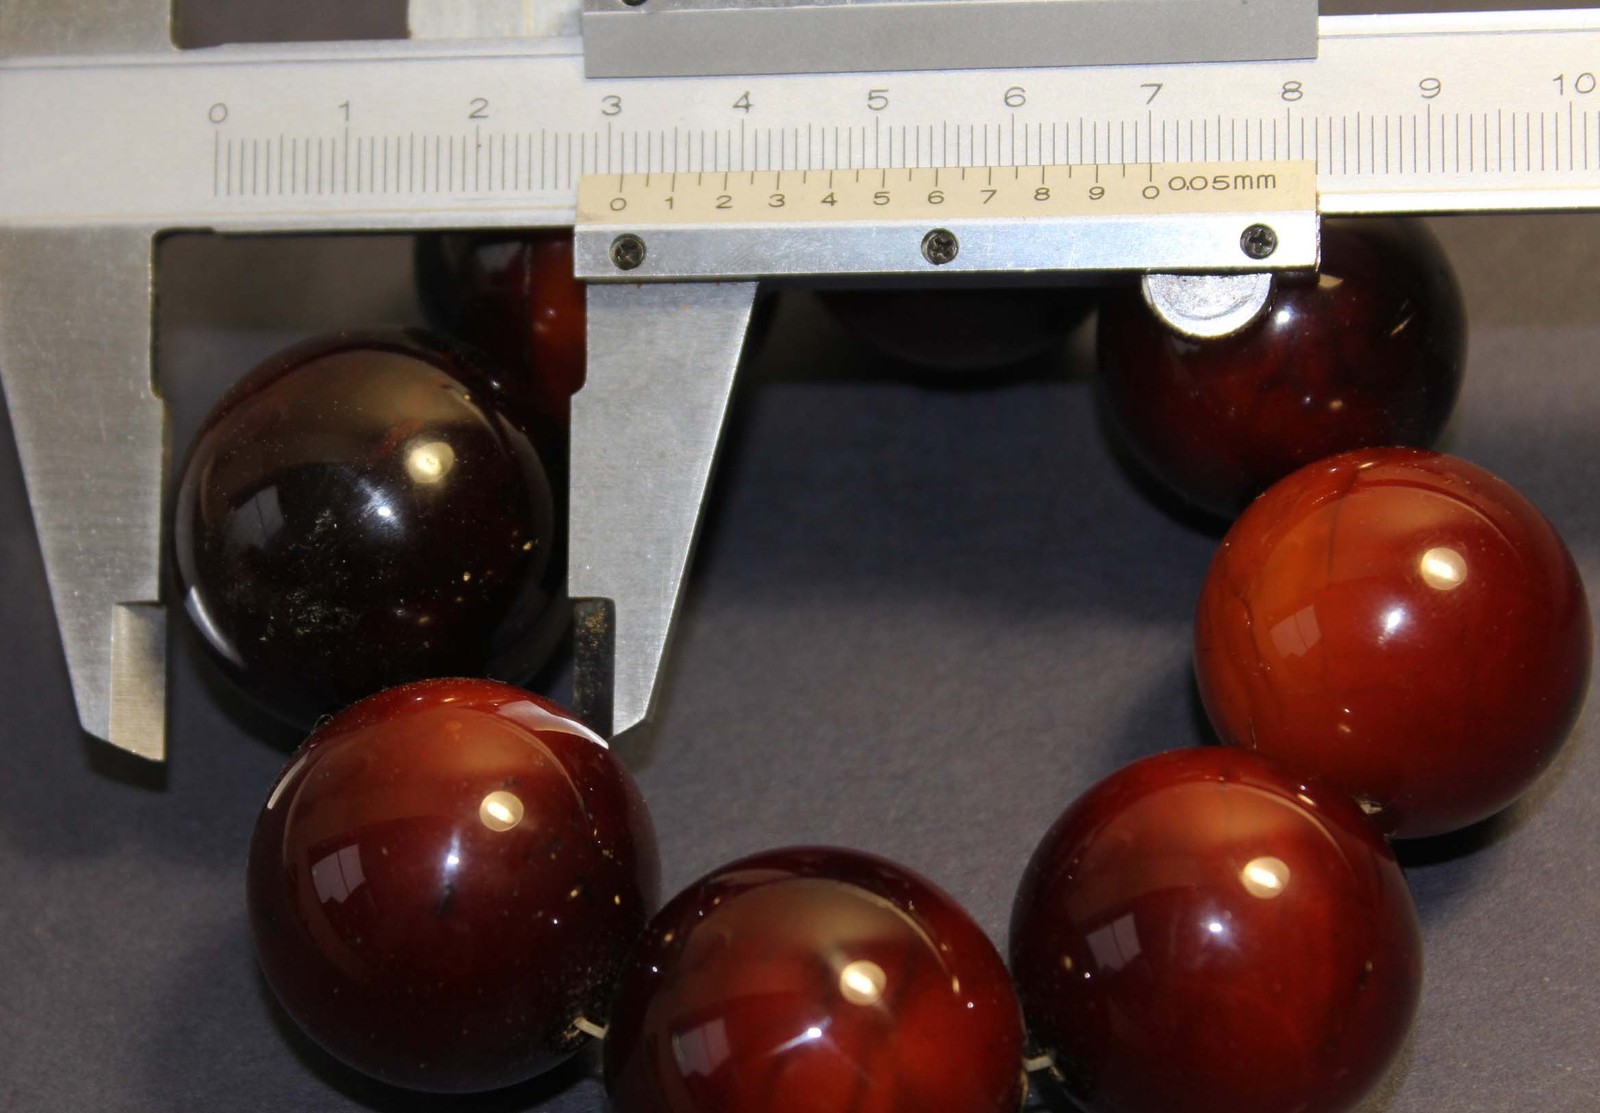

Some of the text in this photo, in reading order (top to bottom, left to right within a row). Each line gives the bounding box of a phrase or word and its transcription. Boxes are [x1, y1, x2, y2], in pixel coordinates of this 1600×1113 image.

[209, 72, 1597, 123] 0 1 2 3 4 5 6 7 8 9 10
[609, 173, 1277, 212] 0 1 2 3 4 5 6 7 8 9 0 0.05mm
